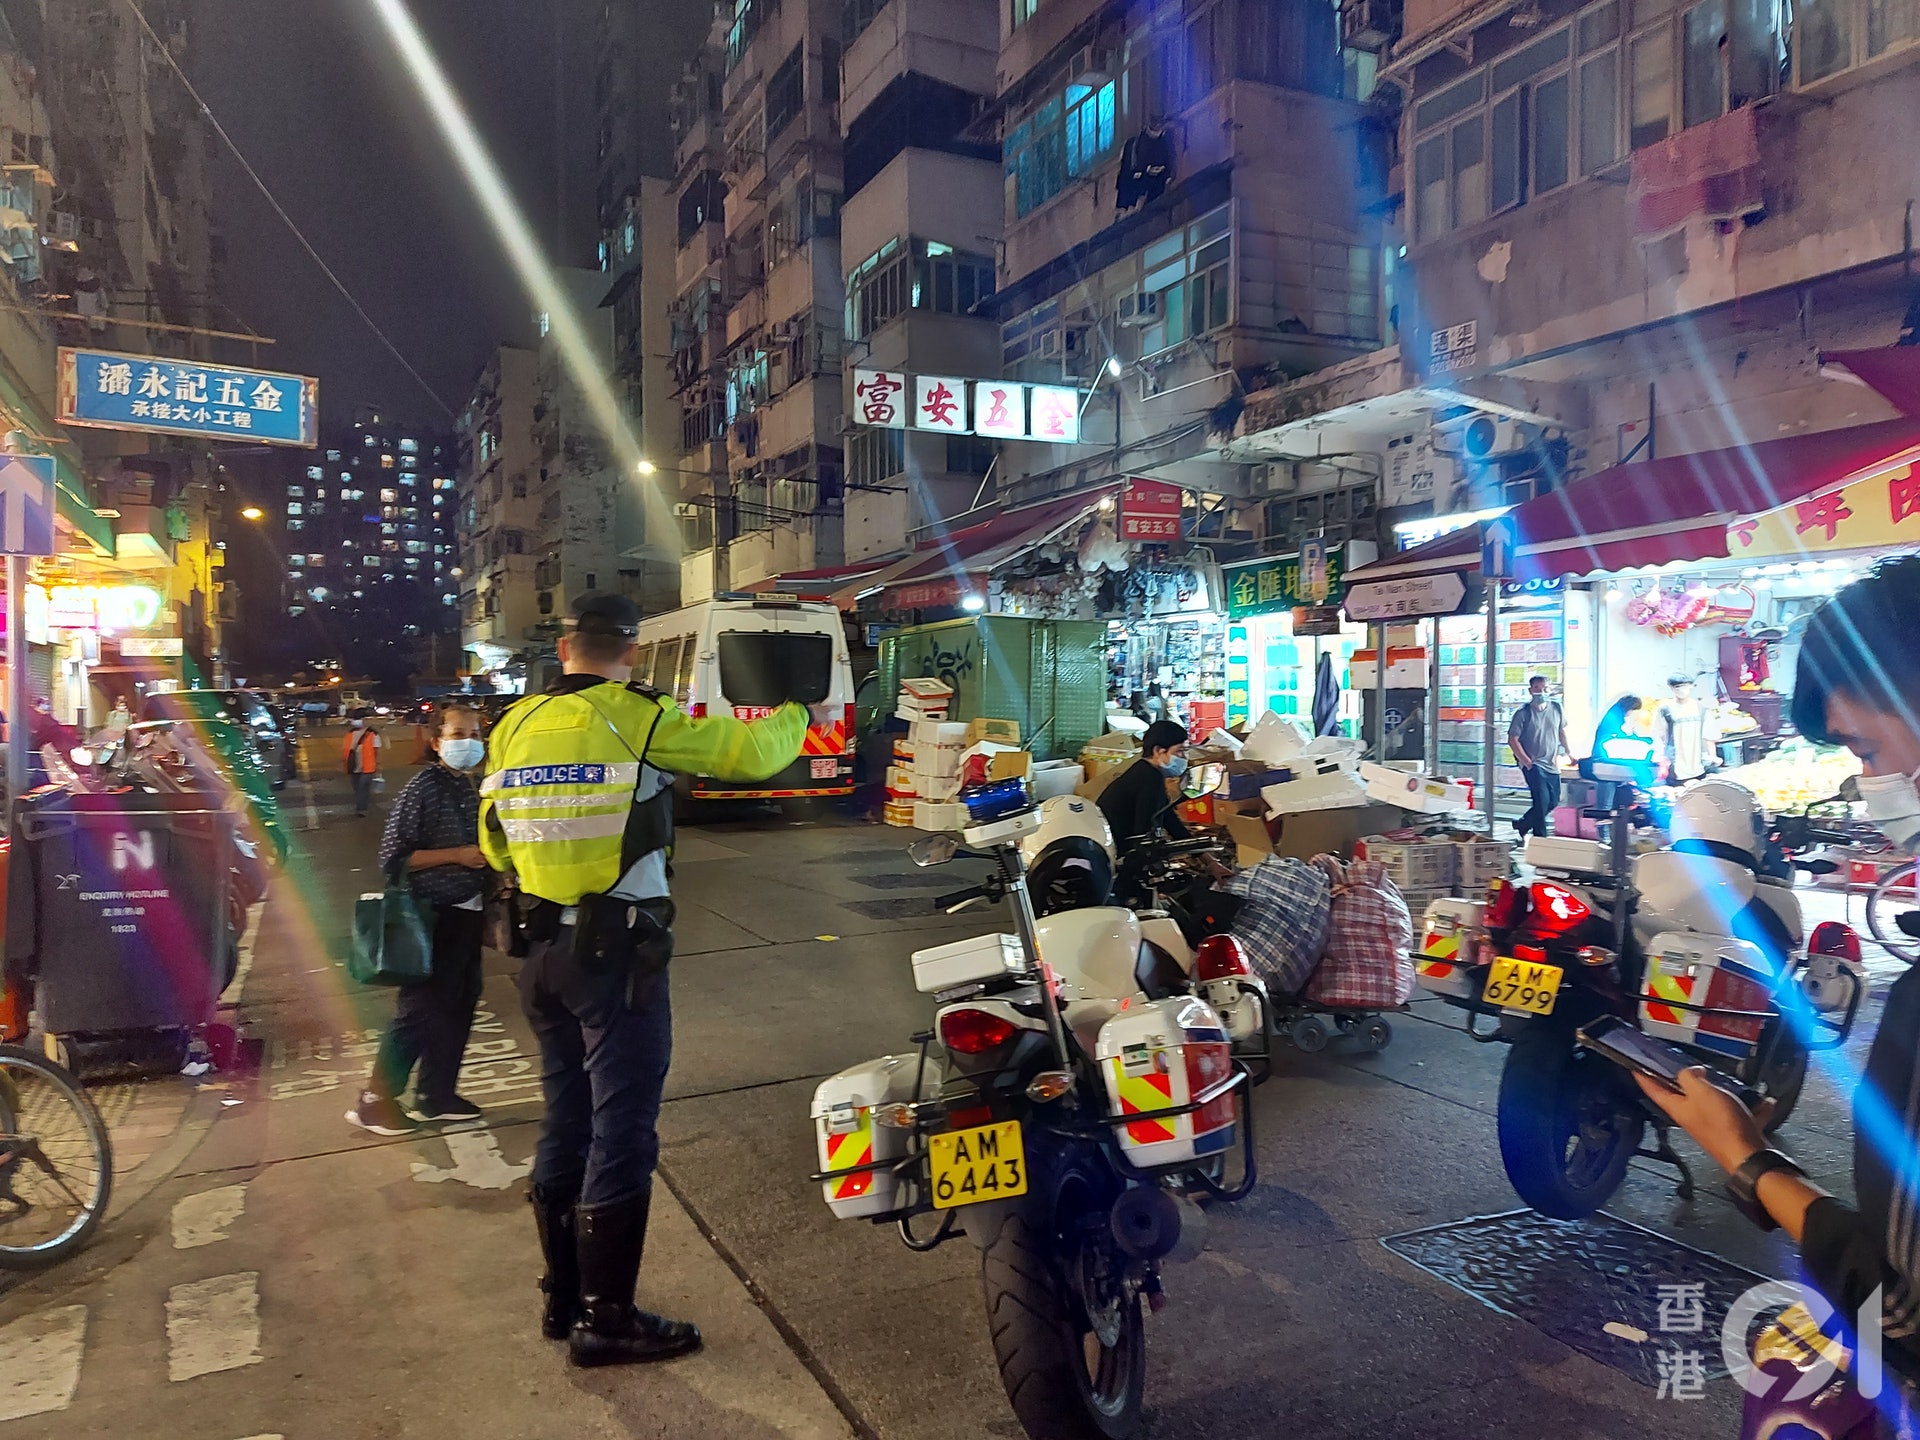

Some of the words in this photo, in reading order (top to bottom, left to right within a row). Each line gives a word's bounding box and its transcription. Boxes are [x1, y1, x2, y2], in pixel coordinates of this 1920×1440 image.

[97, 362, 283, 412] 潘永記五金
[130, 400, 252, 428] 承接大小工程
[856, 372, 1073, 436] 富安五金
[521, 766, 579, 785] POLICE
[1506, 964, 1544, 986] AM
[1488, 981, 1552, 1009] 6799
[954, 1130, 999, 1165] AM
[937, 1158, 1021, 1200] 6443
